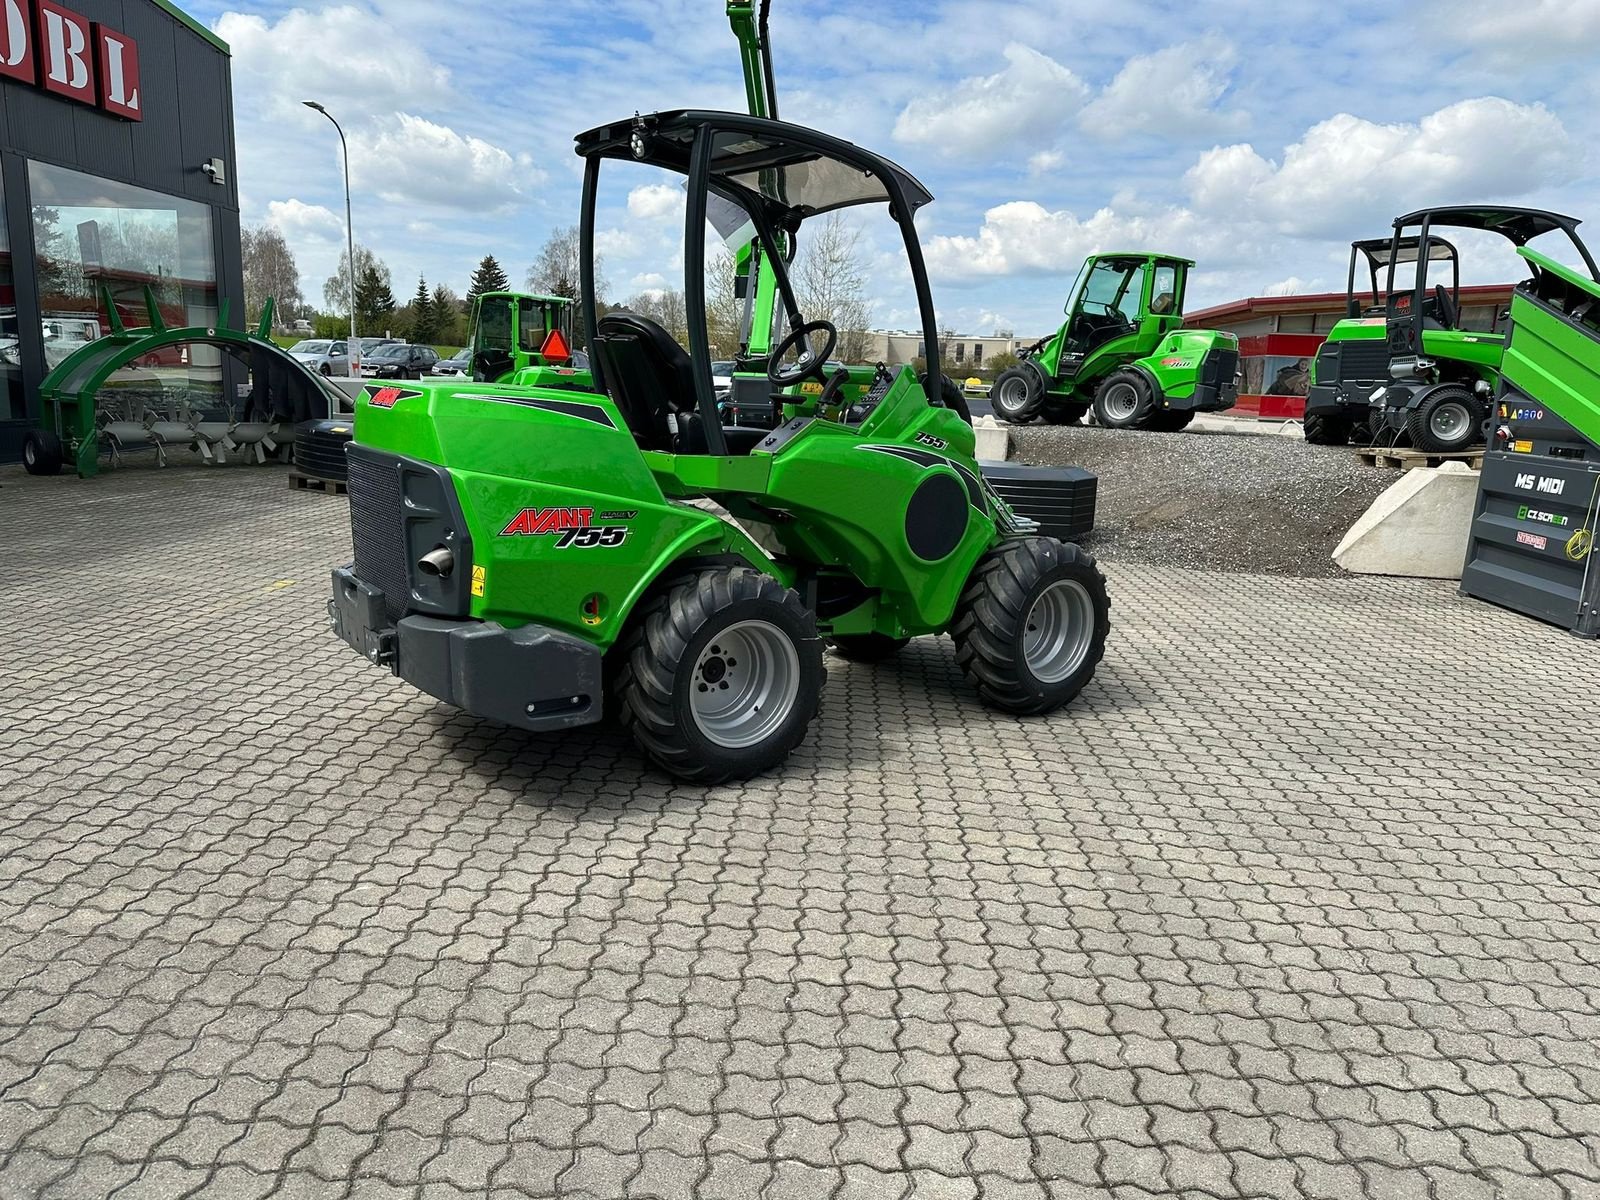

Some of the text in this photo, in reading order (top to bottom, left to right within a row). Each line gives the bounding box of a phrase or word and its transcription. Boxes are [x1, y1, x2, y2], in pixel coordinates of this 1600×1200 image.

[1515, 473, 1565, 495] MS MIDI
[498, 507, 594, 536] AVANT
